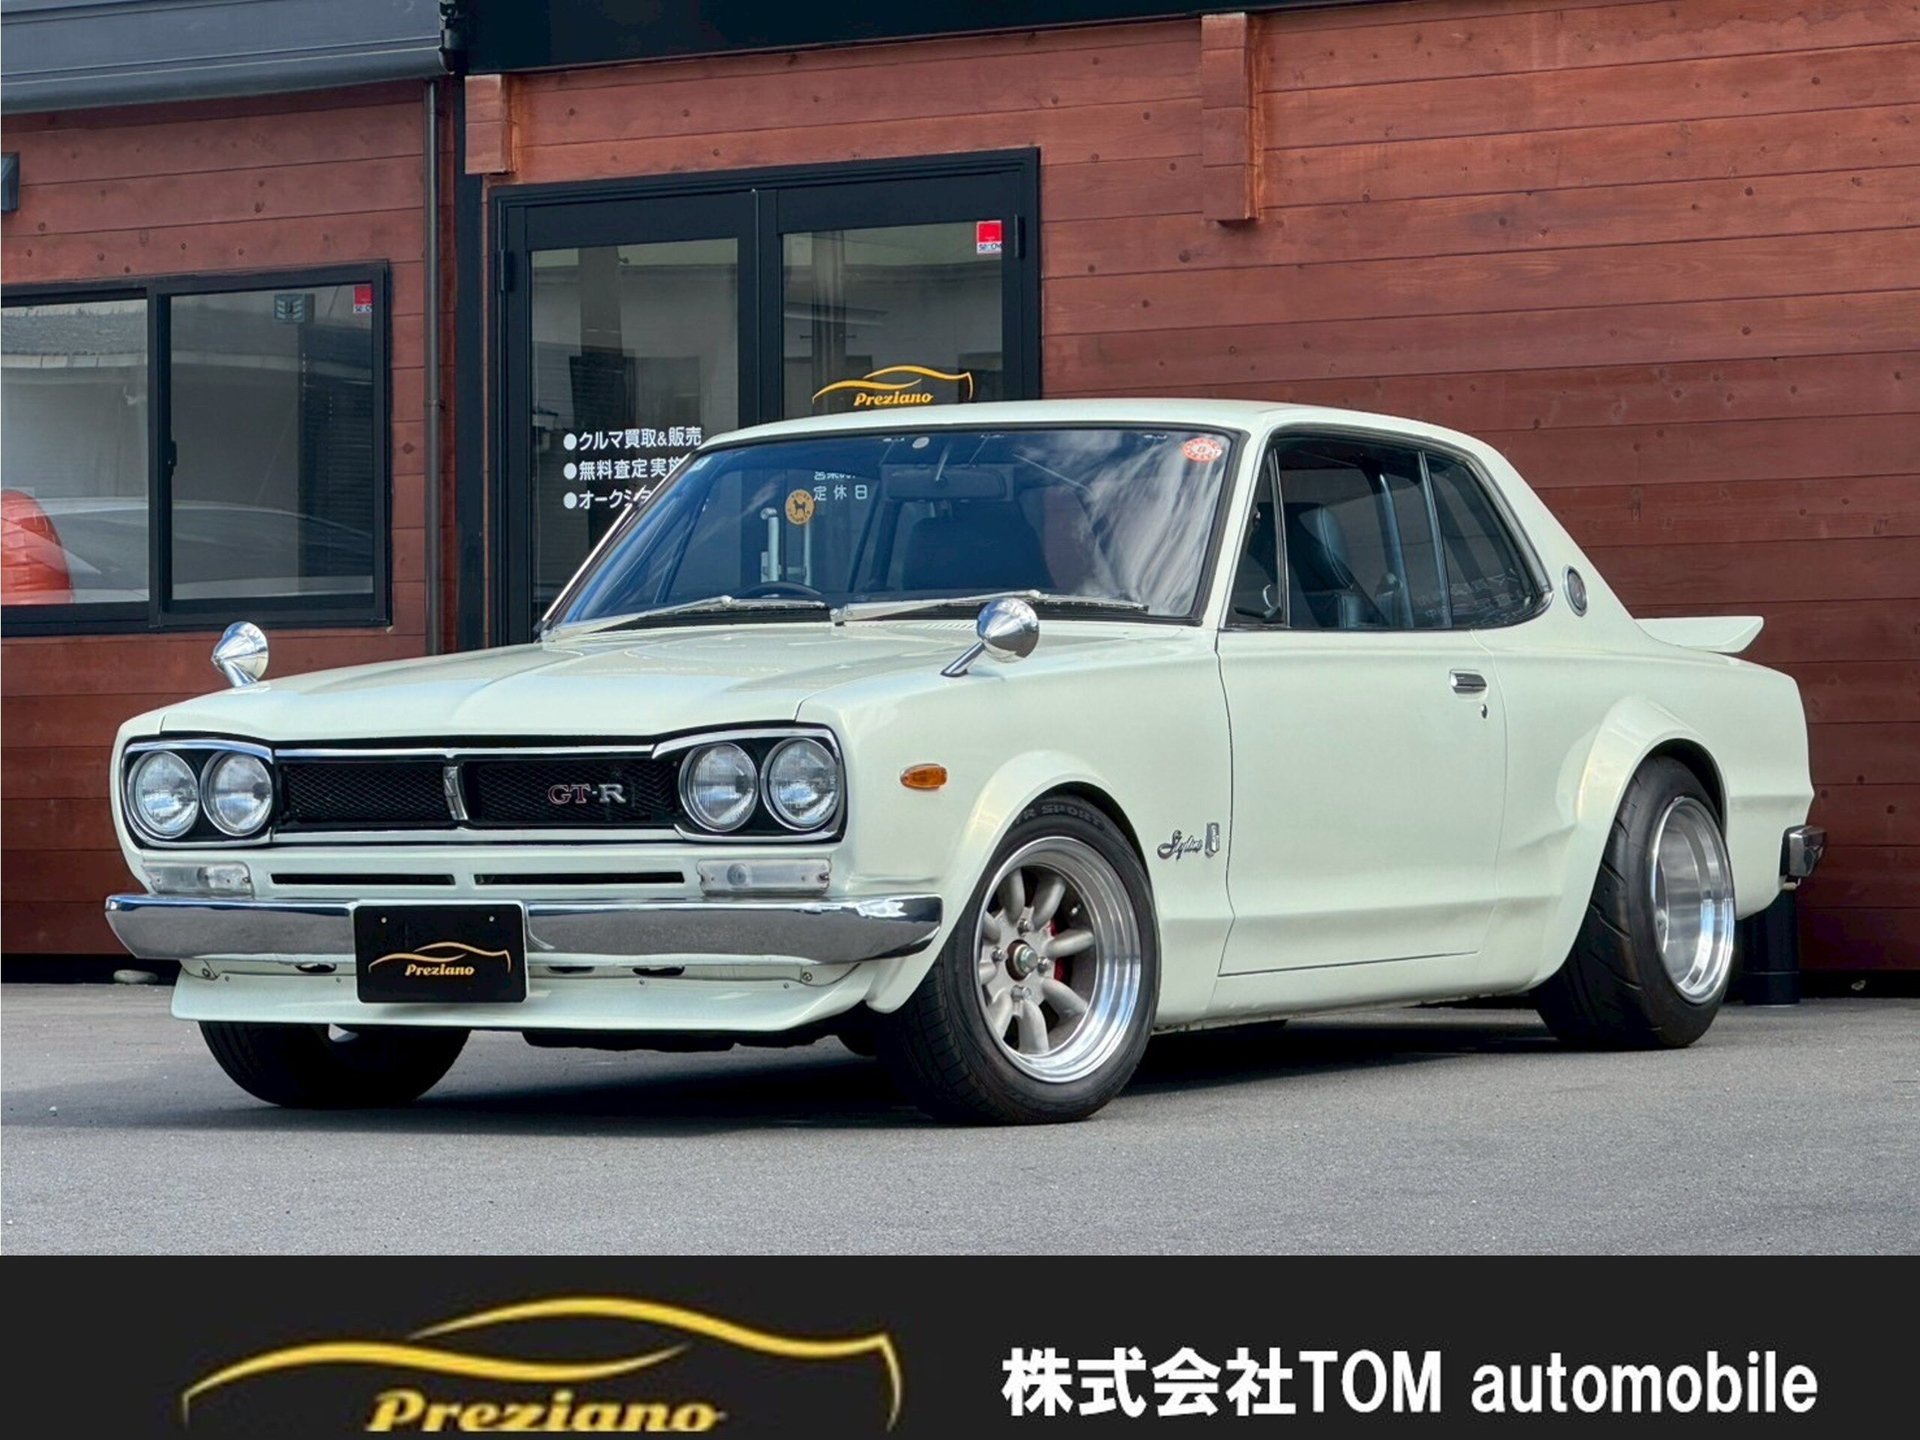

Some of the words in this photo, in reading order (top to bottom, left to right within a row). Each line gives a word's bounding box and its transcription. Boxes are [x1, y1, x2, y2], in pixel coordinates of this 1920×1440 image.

[853, 391, 934, 407] Preziano
[578, 426, 702, 451] クルマ買取&販売
[813, 484, 868, 501] 定休日
[547, 783, 627, 805] GT-R
[404, 963, 476, 977] Preziano
